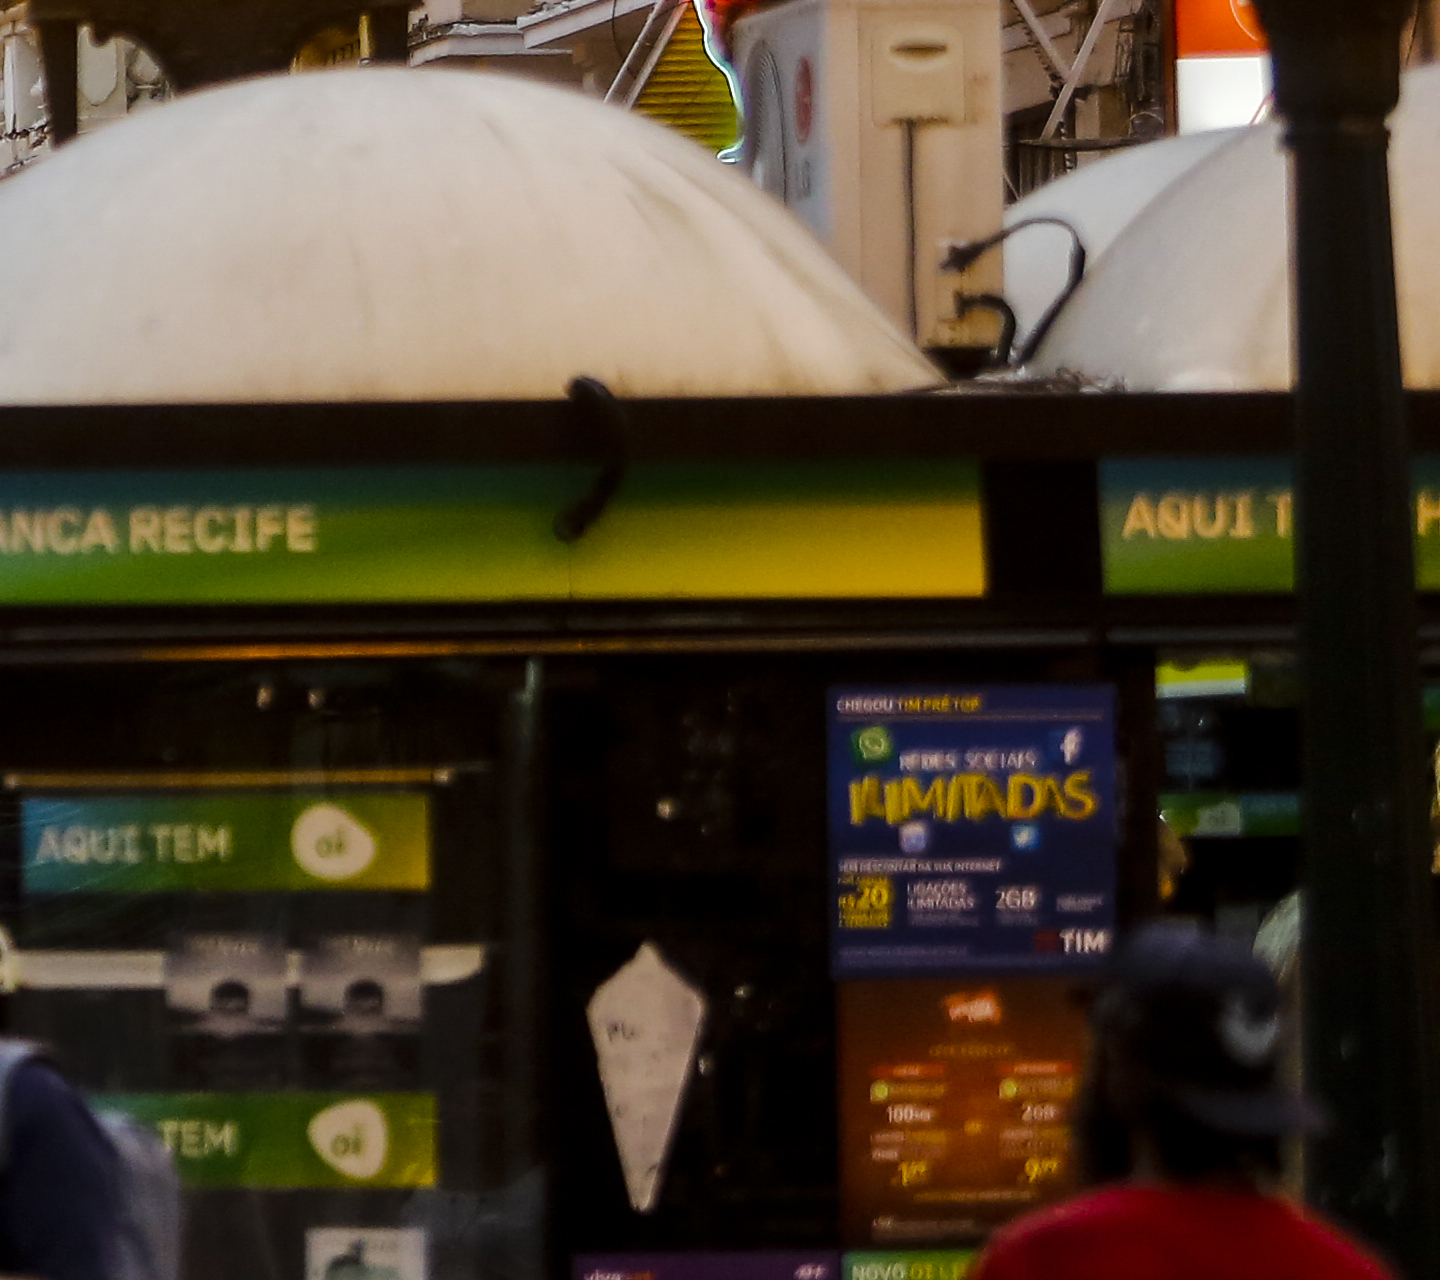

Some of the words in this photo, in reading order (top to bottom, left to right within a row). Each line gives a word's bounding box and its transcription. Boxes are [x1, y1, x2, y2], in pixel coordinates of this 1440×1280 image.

[129, 505, 319, 554] RECIFE
[1122, 491, 1255, 539] AQUI
[36, 825, 143, 865] AQUI
[150, 824, 231, 862] TEM
[1059, 929, 1106, 954] TIM
